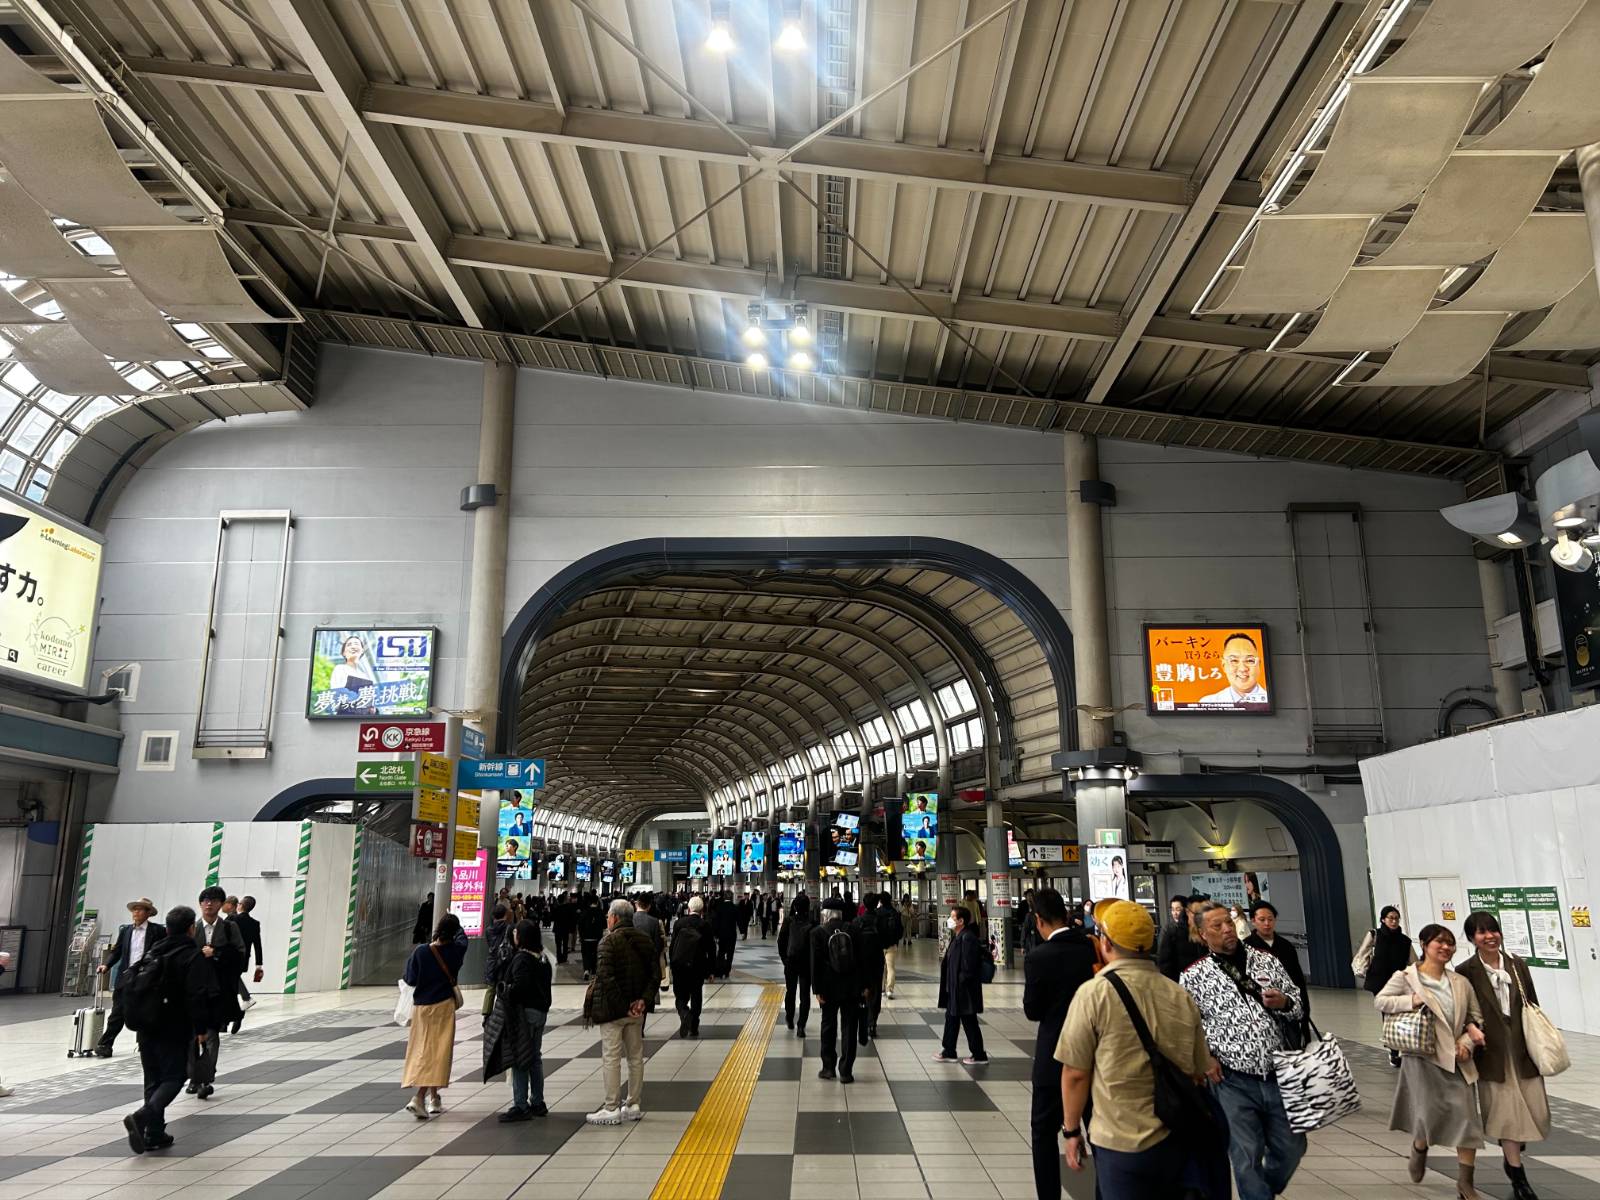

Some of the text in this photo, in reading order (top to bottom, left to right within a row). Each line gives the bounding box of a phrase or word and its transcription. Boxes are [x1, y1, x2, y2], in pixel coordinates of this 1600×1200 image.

[40, 631, 73, 649] kodomo
[1155, 636, 1212, 649] バーキン
[36, 662, 67, 677] career
[1155, 662, 1222, 682] 豊胸しろ
[386, 733, 400, 741] KK
[380, 765, 406, 775] 北改札
[478, 762, 504, 771] 新幹線
[458, 869, 478, 881] 品川
[451, 880, 484, 892] 容外科
